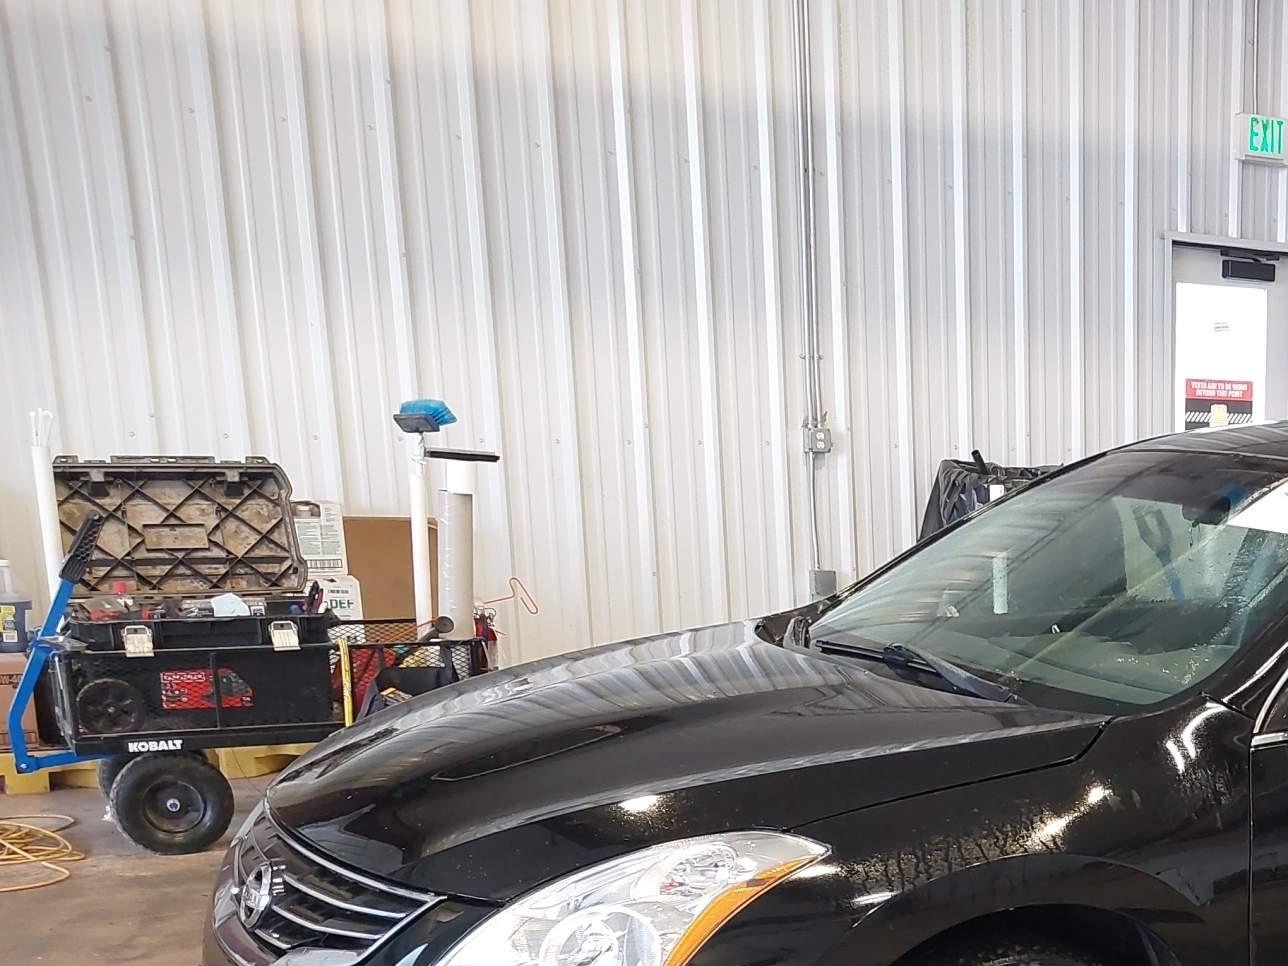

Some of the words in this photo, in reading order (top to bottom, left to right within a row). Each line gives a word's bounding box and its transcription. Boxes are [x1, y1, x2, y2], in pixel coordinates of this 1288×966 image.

[1249, 116, 1284, 155] EXIT
[1217, 382, 1225, 390] TO
[128, 739, 183, 753] KOBALT
